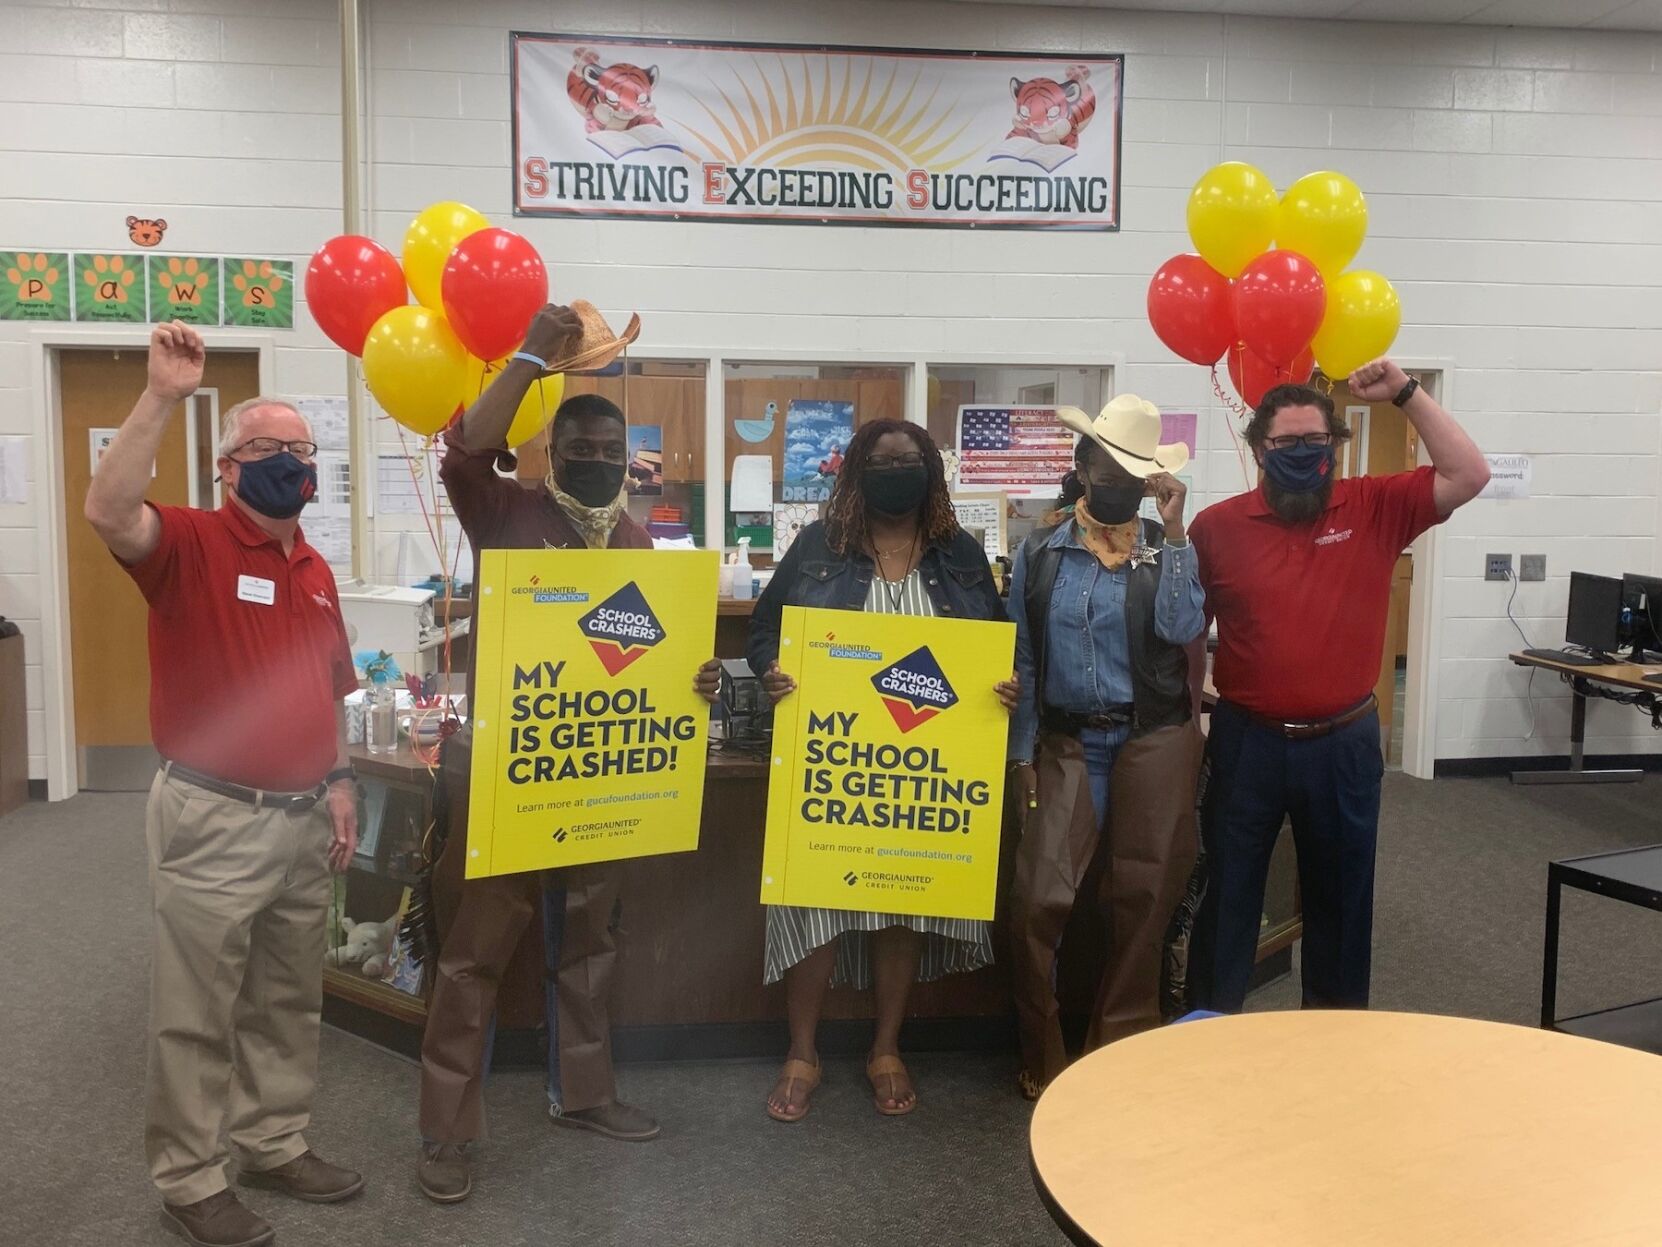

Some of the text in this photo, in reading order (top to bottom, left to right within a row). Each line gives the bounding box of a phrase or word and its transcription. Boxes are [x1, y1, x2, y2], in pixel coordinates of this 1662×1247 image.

[523, 156, 1107, 213] STRIVING EXCEEDING SUCCEEDING
[783, 486, 831, 502] DREA
[596, 607, 652, 628] SCHOOL
[513, 661, 566, 690] MY
[889, 667, 944, 691] SCHOOL
[510, 688, 656, 722] SCHOOL
[510, 715, 696, 753] IS GETTING
[808, 710, 859, 736] MY
[507, 746, 678, 785] CRASHED!
[805, 739, 948, 773] SCHOOL
[804, 768, 990, 806] IS GETTING
[517, 789, 679, 813] Learn more at gucufoundation.org
[801, 798, 971, 834] CRASHED!
[575, 829, 635, 842] CREDIT UNION
[809, 841, 973, 863] Learn more at gucufoundation.org
[866, 882, 894, 891] CREDIT
